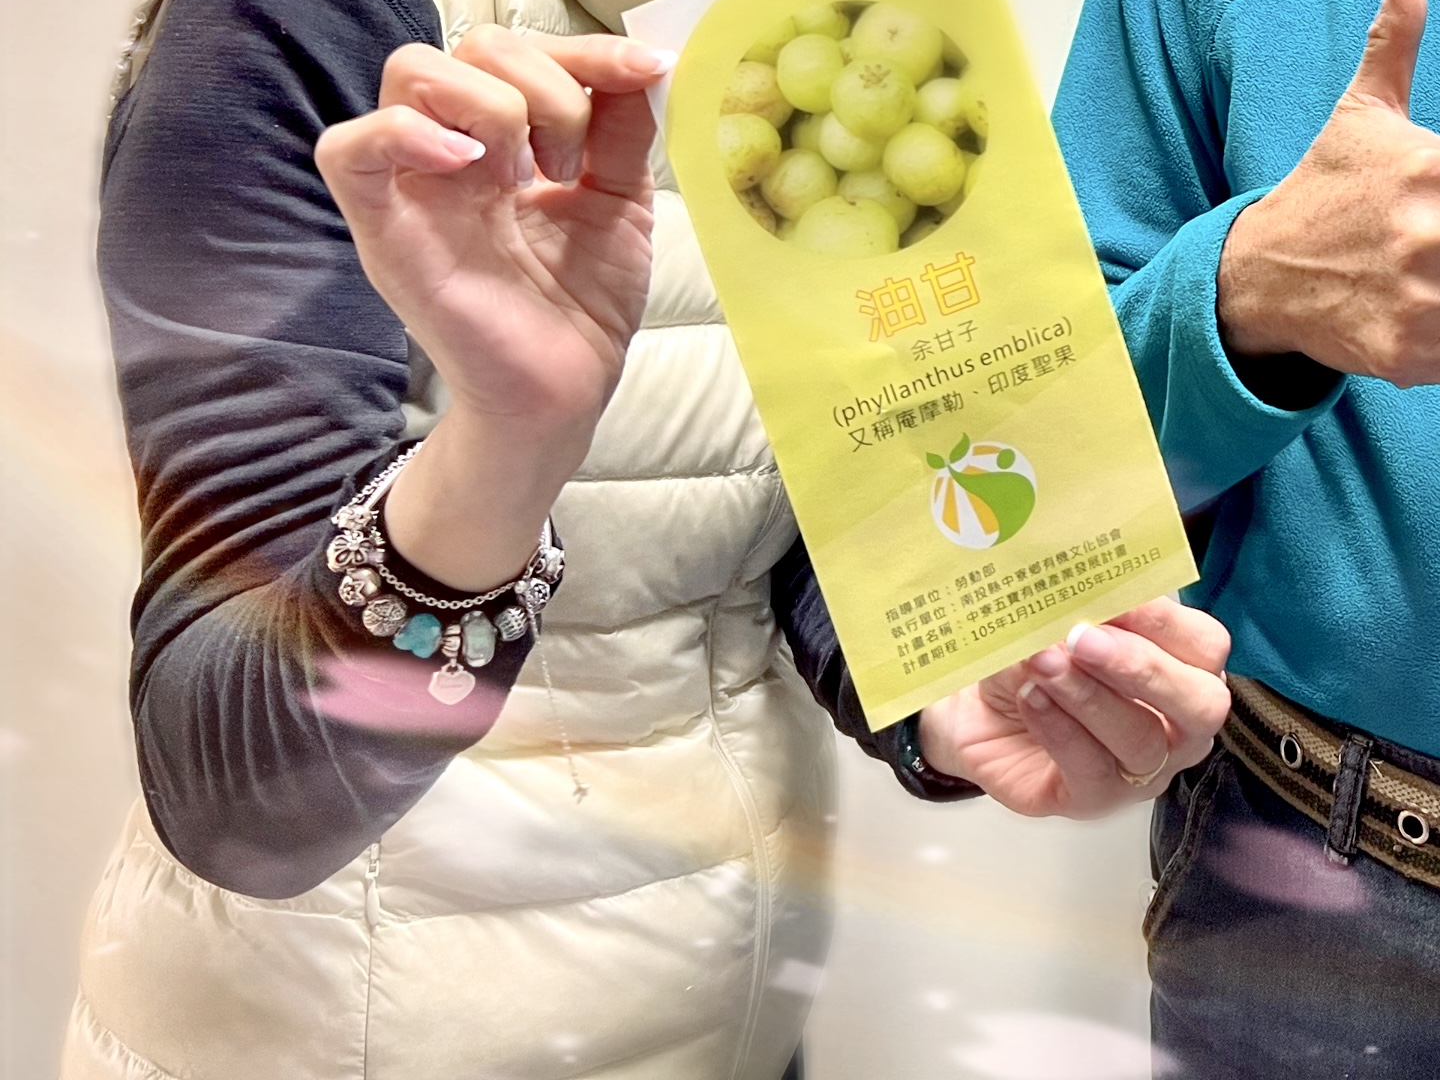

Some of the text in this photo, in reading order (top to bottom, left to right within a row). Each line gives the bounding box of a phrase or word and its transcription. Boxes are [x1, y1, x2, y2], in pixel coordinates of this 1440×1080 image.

[855, 251, 982, 343] 油甘
[910, 319, 978, 362] 余甘子
[833, 316, 1073, 428] (phyllanthus emblica)
